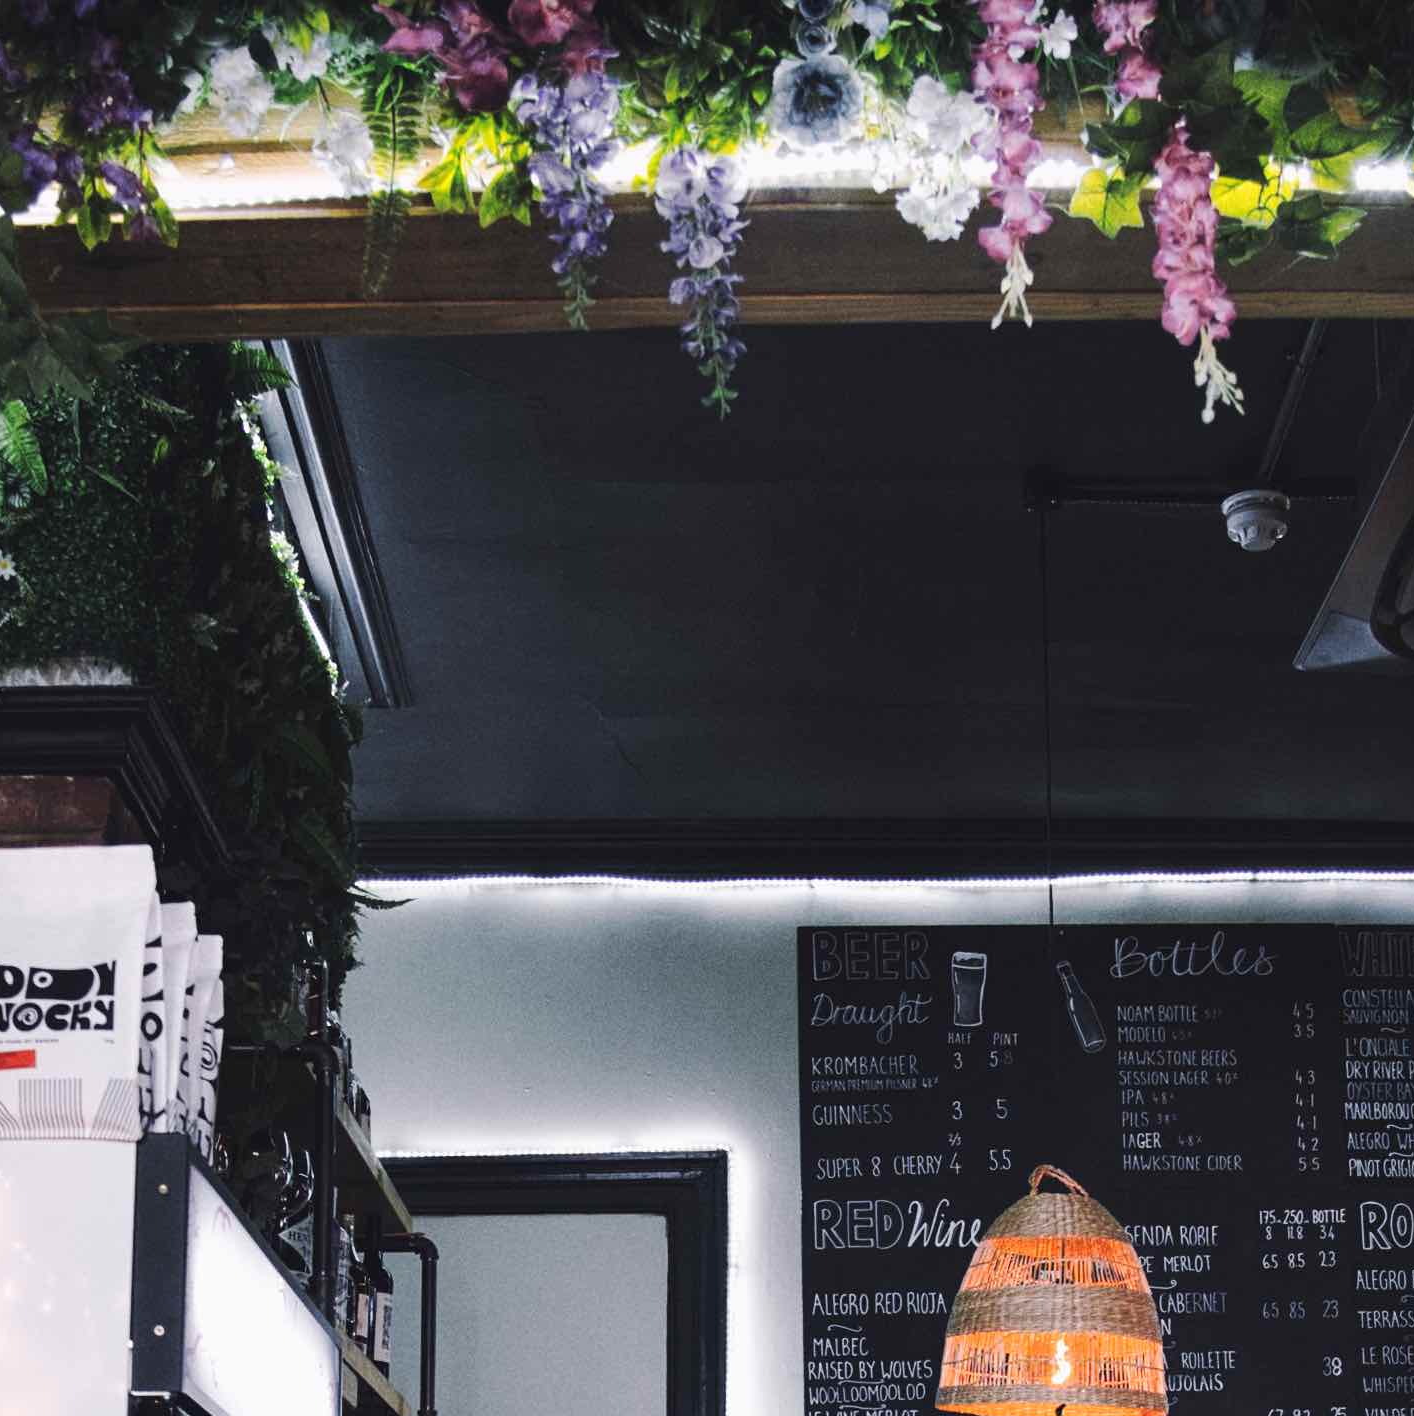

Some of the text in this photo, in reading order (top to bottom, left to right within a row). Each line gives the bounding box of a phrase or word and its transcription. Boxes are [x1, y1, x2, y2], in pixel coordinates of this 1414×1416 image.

[812, 931, 931, 981] BEER
[1110, 931, 1277, 978] Bottles
[811, 992, 933, 1044] Draught
[993, 1032, 1019, 1045] PINT
[811, 1055, 919, 1075] KROMBACHER
[1118, 1049, 1237, 1066] HAWKSTONE BEERS
[1119, 1071, 1209, 1086] SESSION LAGER
[1346, 1061, 1369, 1080] DRY
[1373, 1061, 1405, 1080] RIVER
[1122, 1089, 1144, 1105] IPA
[1347, 1082, 1394, 1101] OYSTER
[812, 1099, 1008, 1125] GUINNESS 3 5
[1122, 1112, 1149, 1127] PILS
[1347, 1132, 1390, 1151] ALEGRO
[817, 1157, 863, 1180] SUPER
[872, 1156, 881, 1176] 8
[893, 1155, 942, 1176] CHERRY
[1123, 1155, 1243, 1171] HAWKSTONE CIDER
[1349, 1159, 1380, 1177] PINOT
[814, 1199, 982, 1250] RED Wine
[1312, 1208, 1346, 1225] BOTTLE
[1164, 1255, 1212, 1273] MERLOT
[1356, 1270, 1407, 1291] ALEGRO
[812, 1291, 947, 1316] ALEGRO RED RIOJA
[1159, 1292, 1227, 1314] CABERNET
[813, 1336, 869, 1357] MALBEC
[1362, 1345, 1414, 1365] LE ROSE
[808, 1359, 933, 1381] RAISED BY WOLVES
